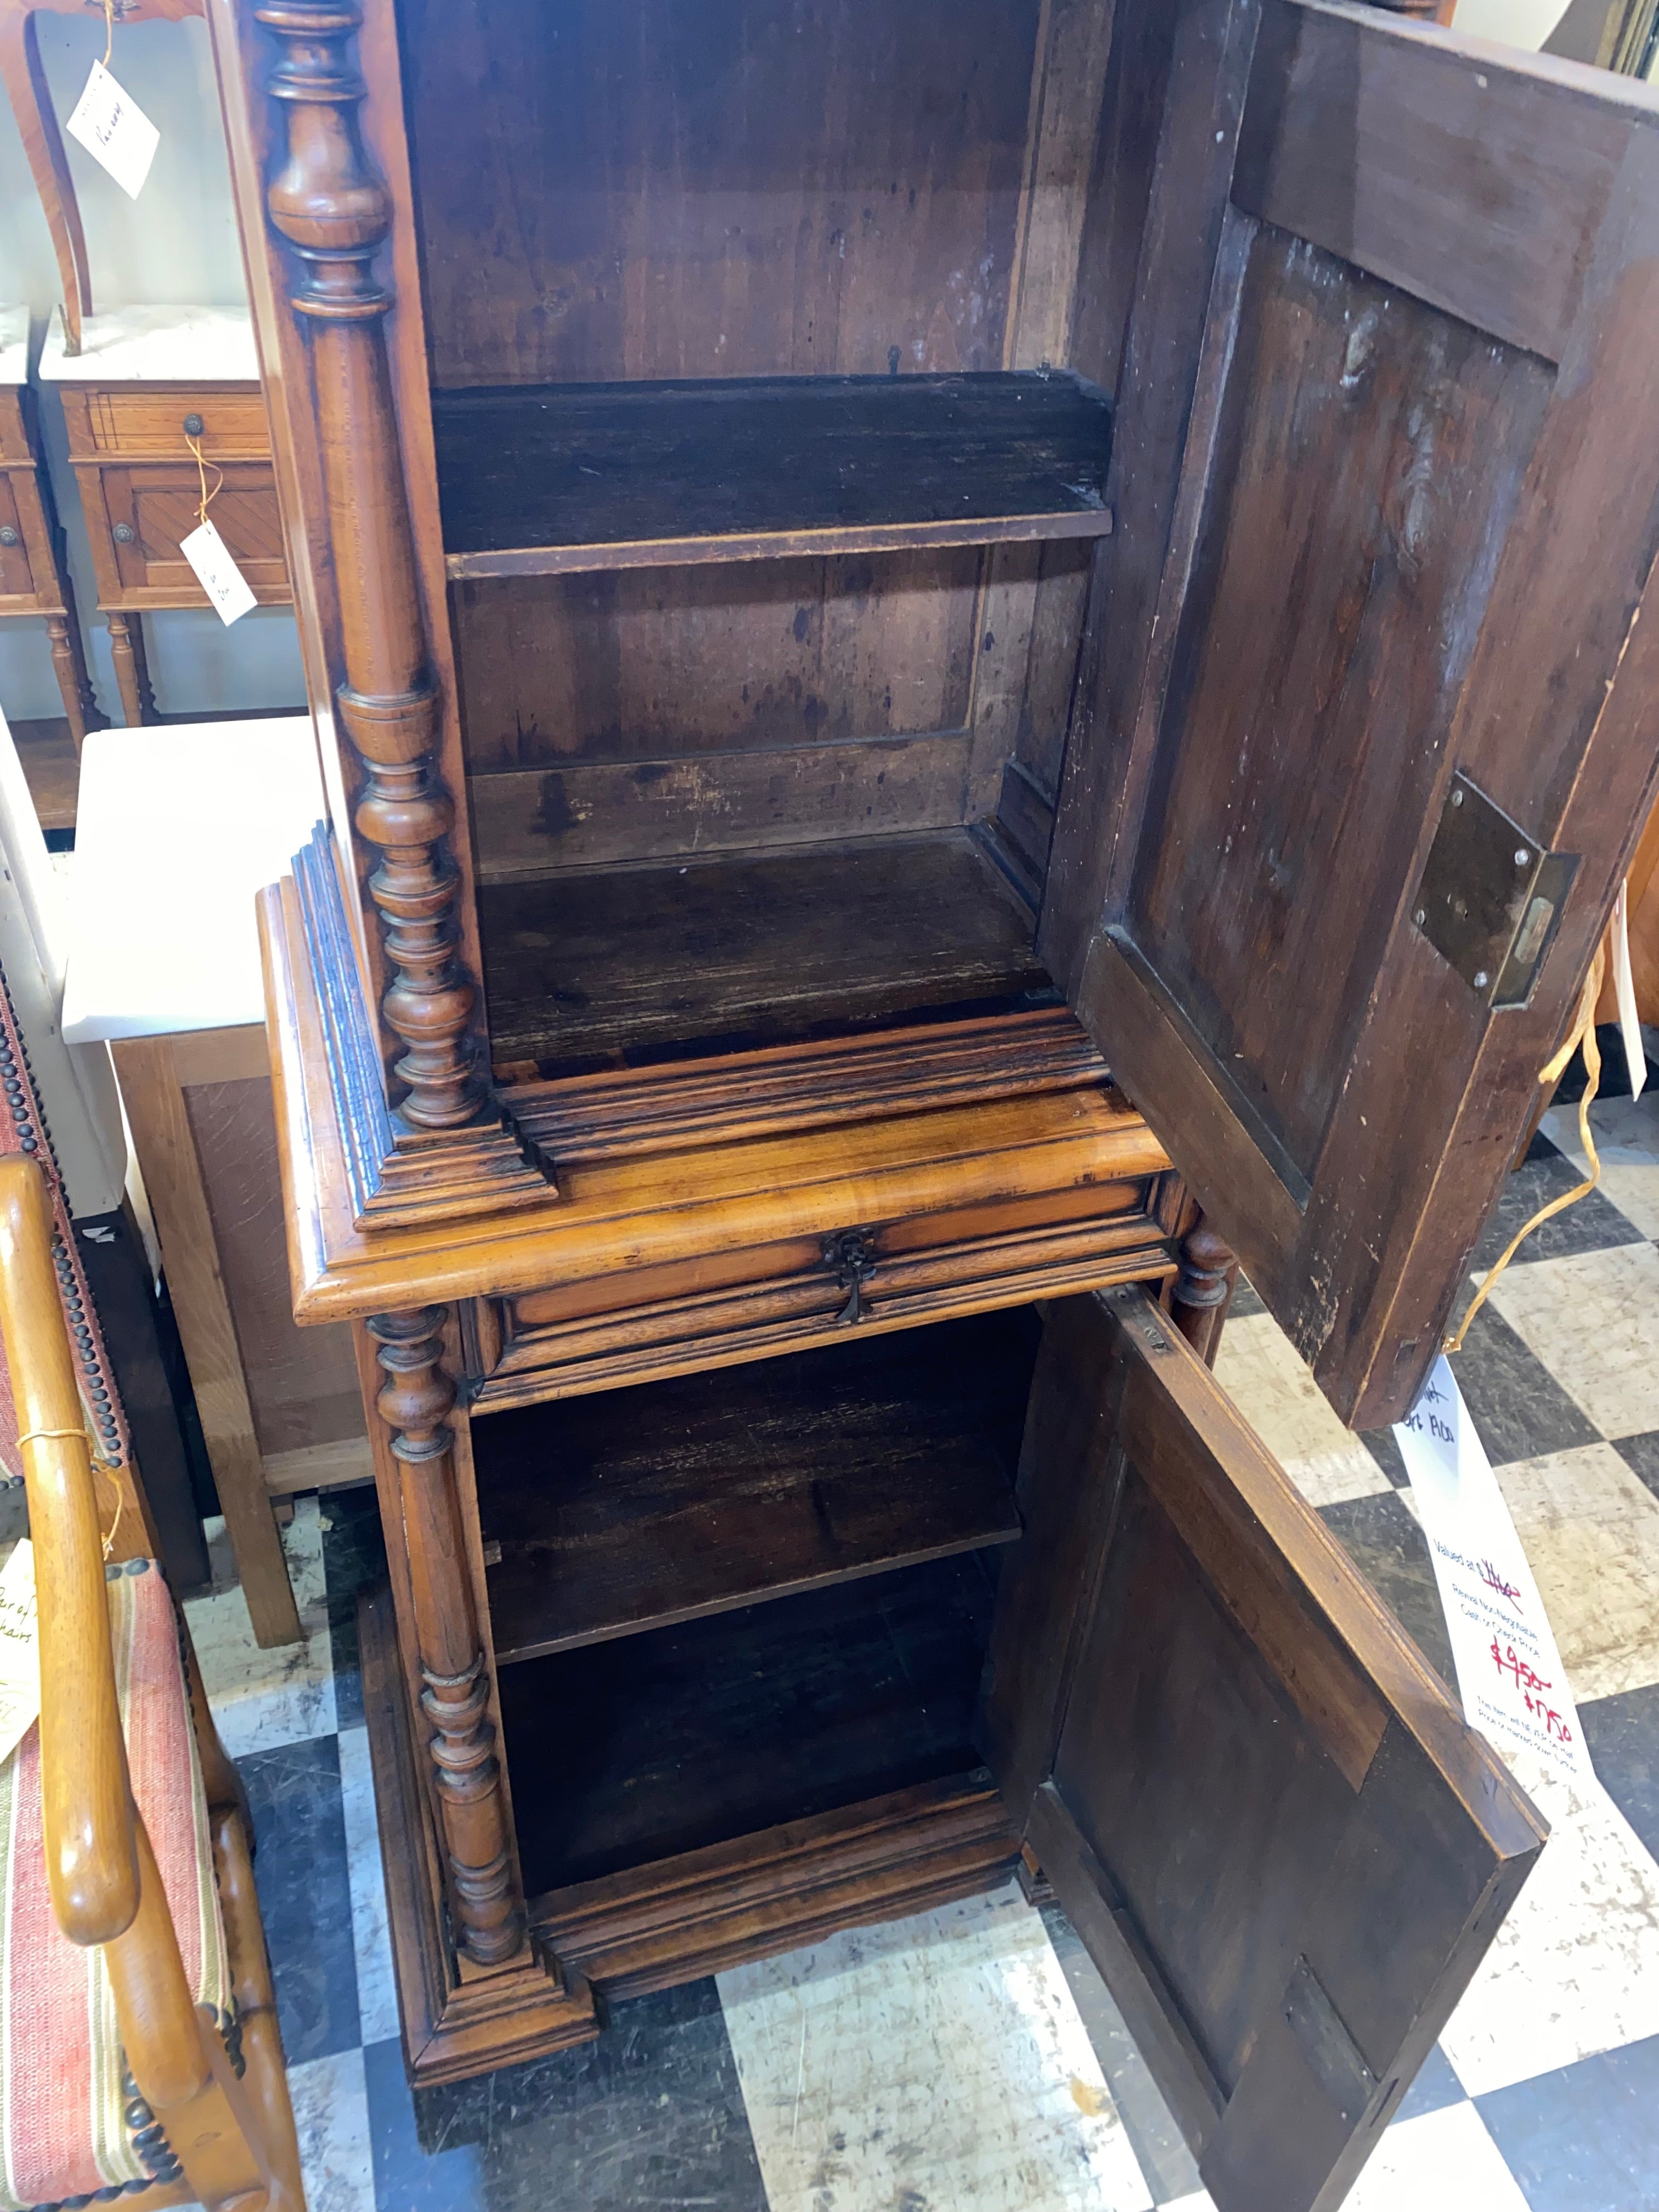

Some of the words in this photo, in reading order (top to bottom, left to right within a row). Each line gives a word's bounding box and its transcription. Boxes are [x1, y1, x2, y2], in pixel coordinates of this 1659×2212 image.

[1433, 1538, 1464, 1566] Valued
[1490, 1634, 1552, 1691] $950
[1523, 1689, 1572, 1742] $750
